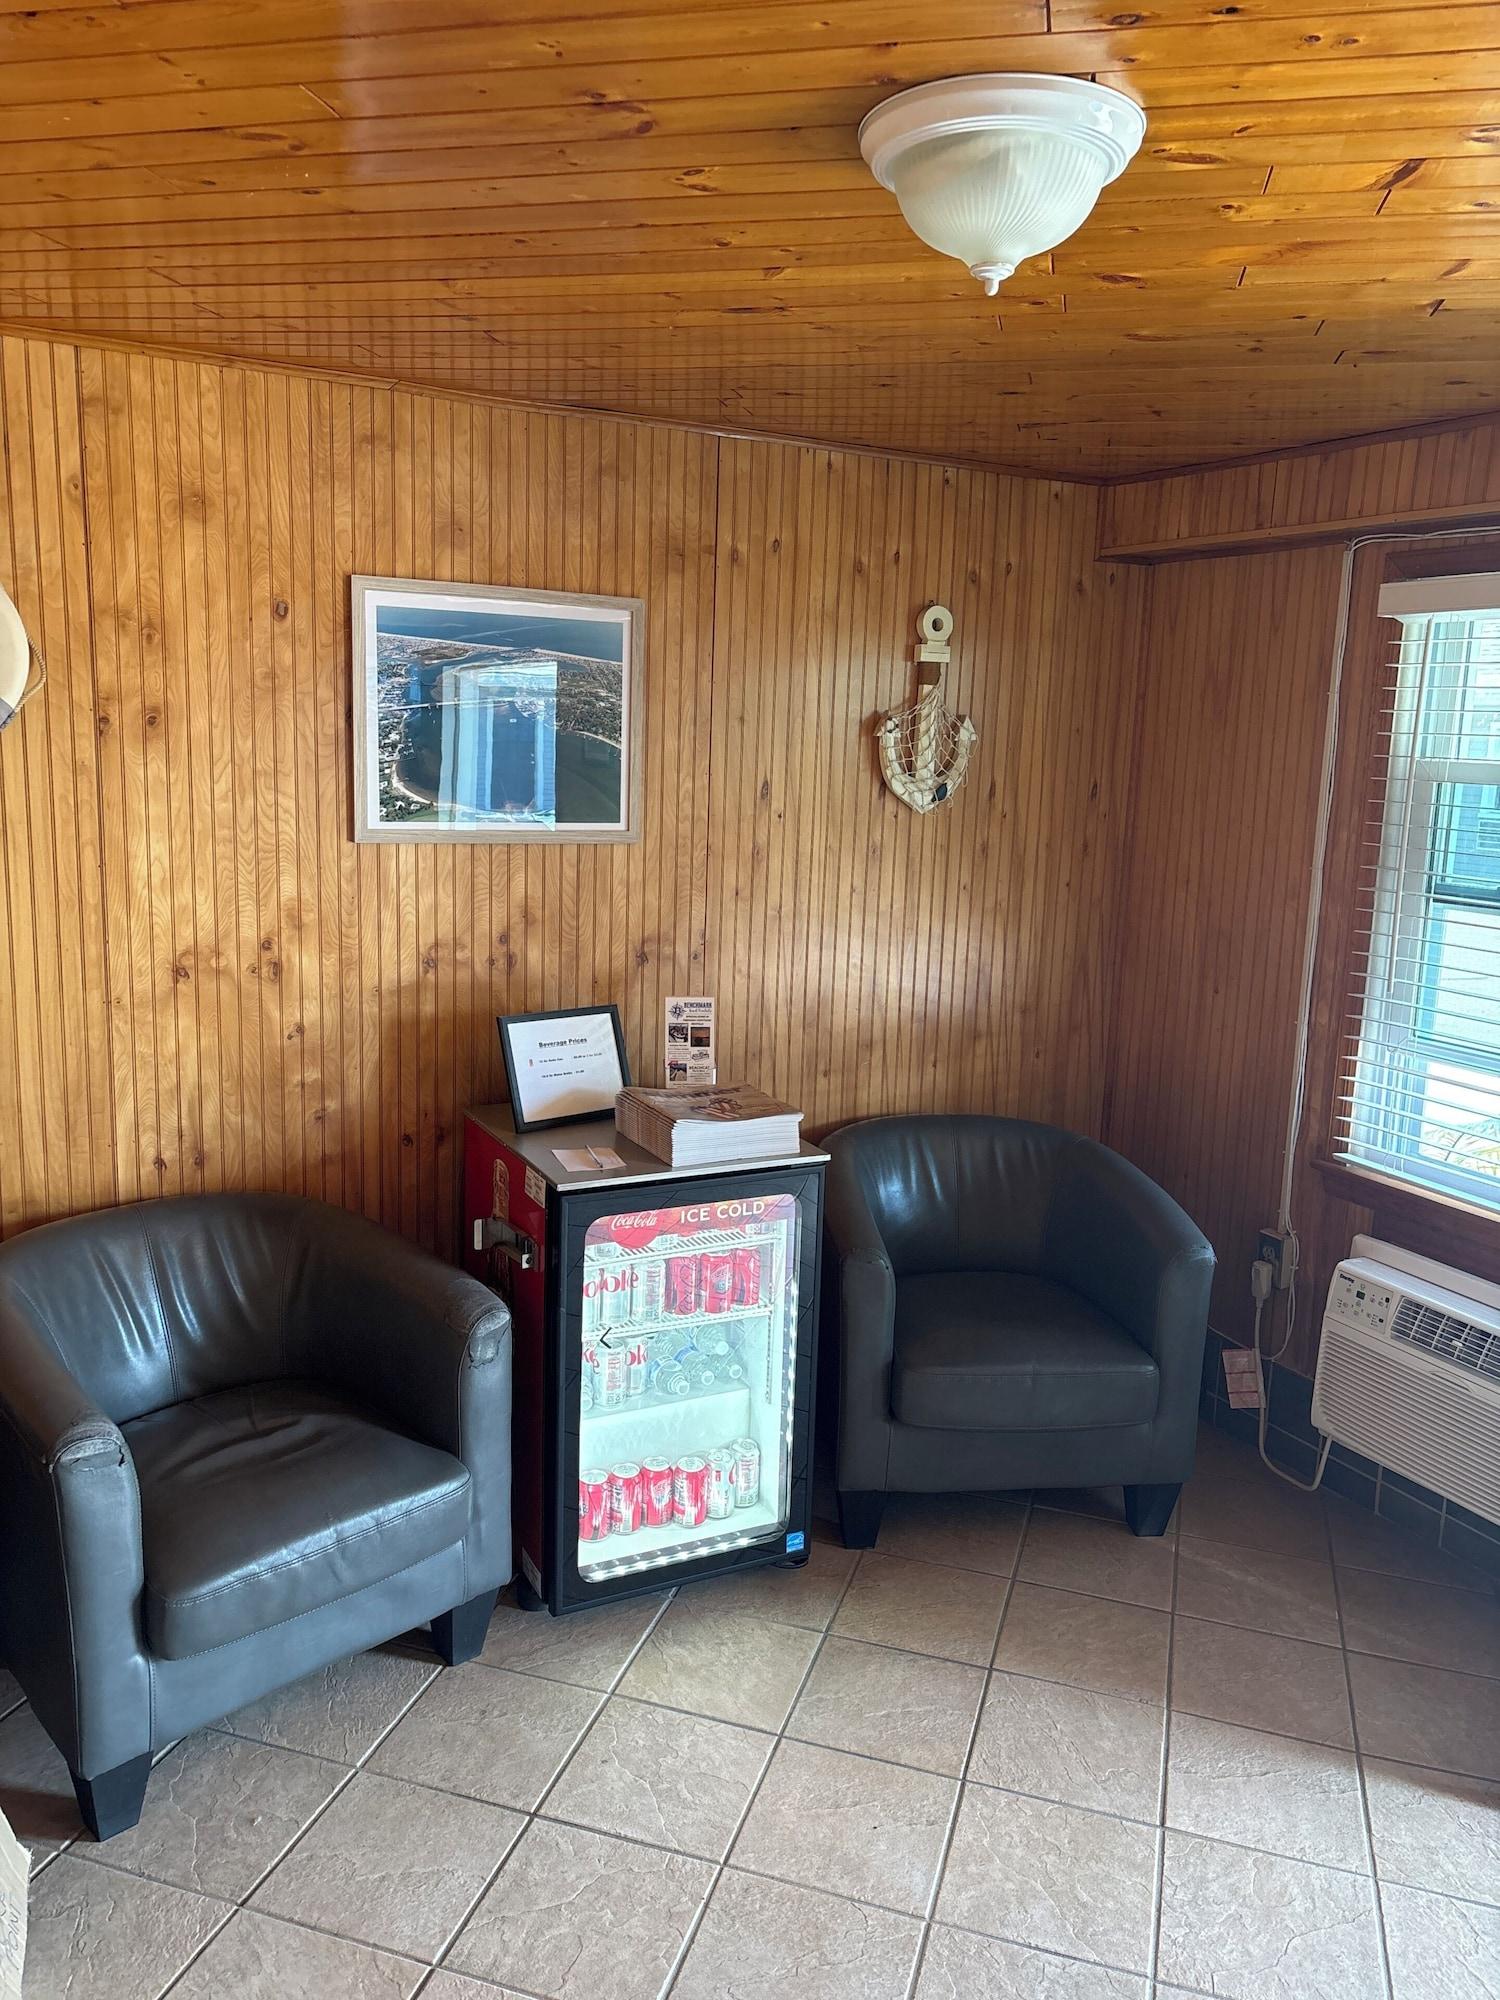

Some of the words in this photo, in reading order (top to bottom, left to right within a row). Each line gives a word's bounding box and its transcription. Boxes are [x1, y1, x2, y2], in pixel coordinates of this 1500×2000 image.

[538, 1040, 567, 1048] Beverage
[568, 1037, 588, 1045] Prices
[611, 1211, 658, 1231] Coca-Cola
[679, 1207, 711, 1224] ICE
[716, 1201, 766, 1219] COLD
